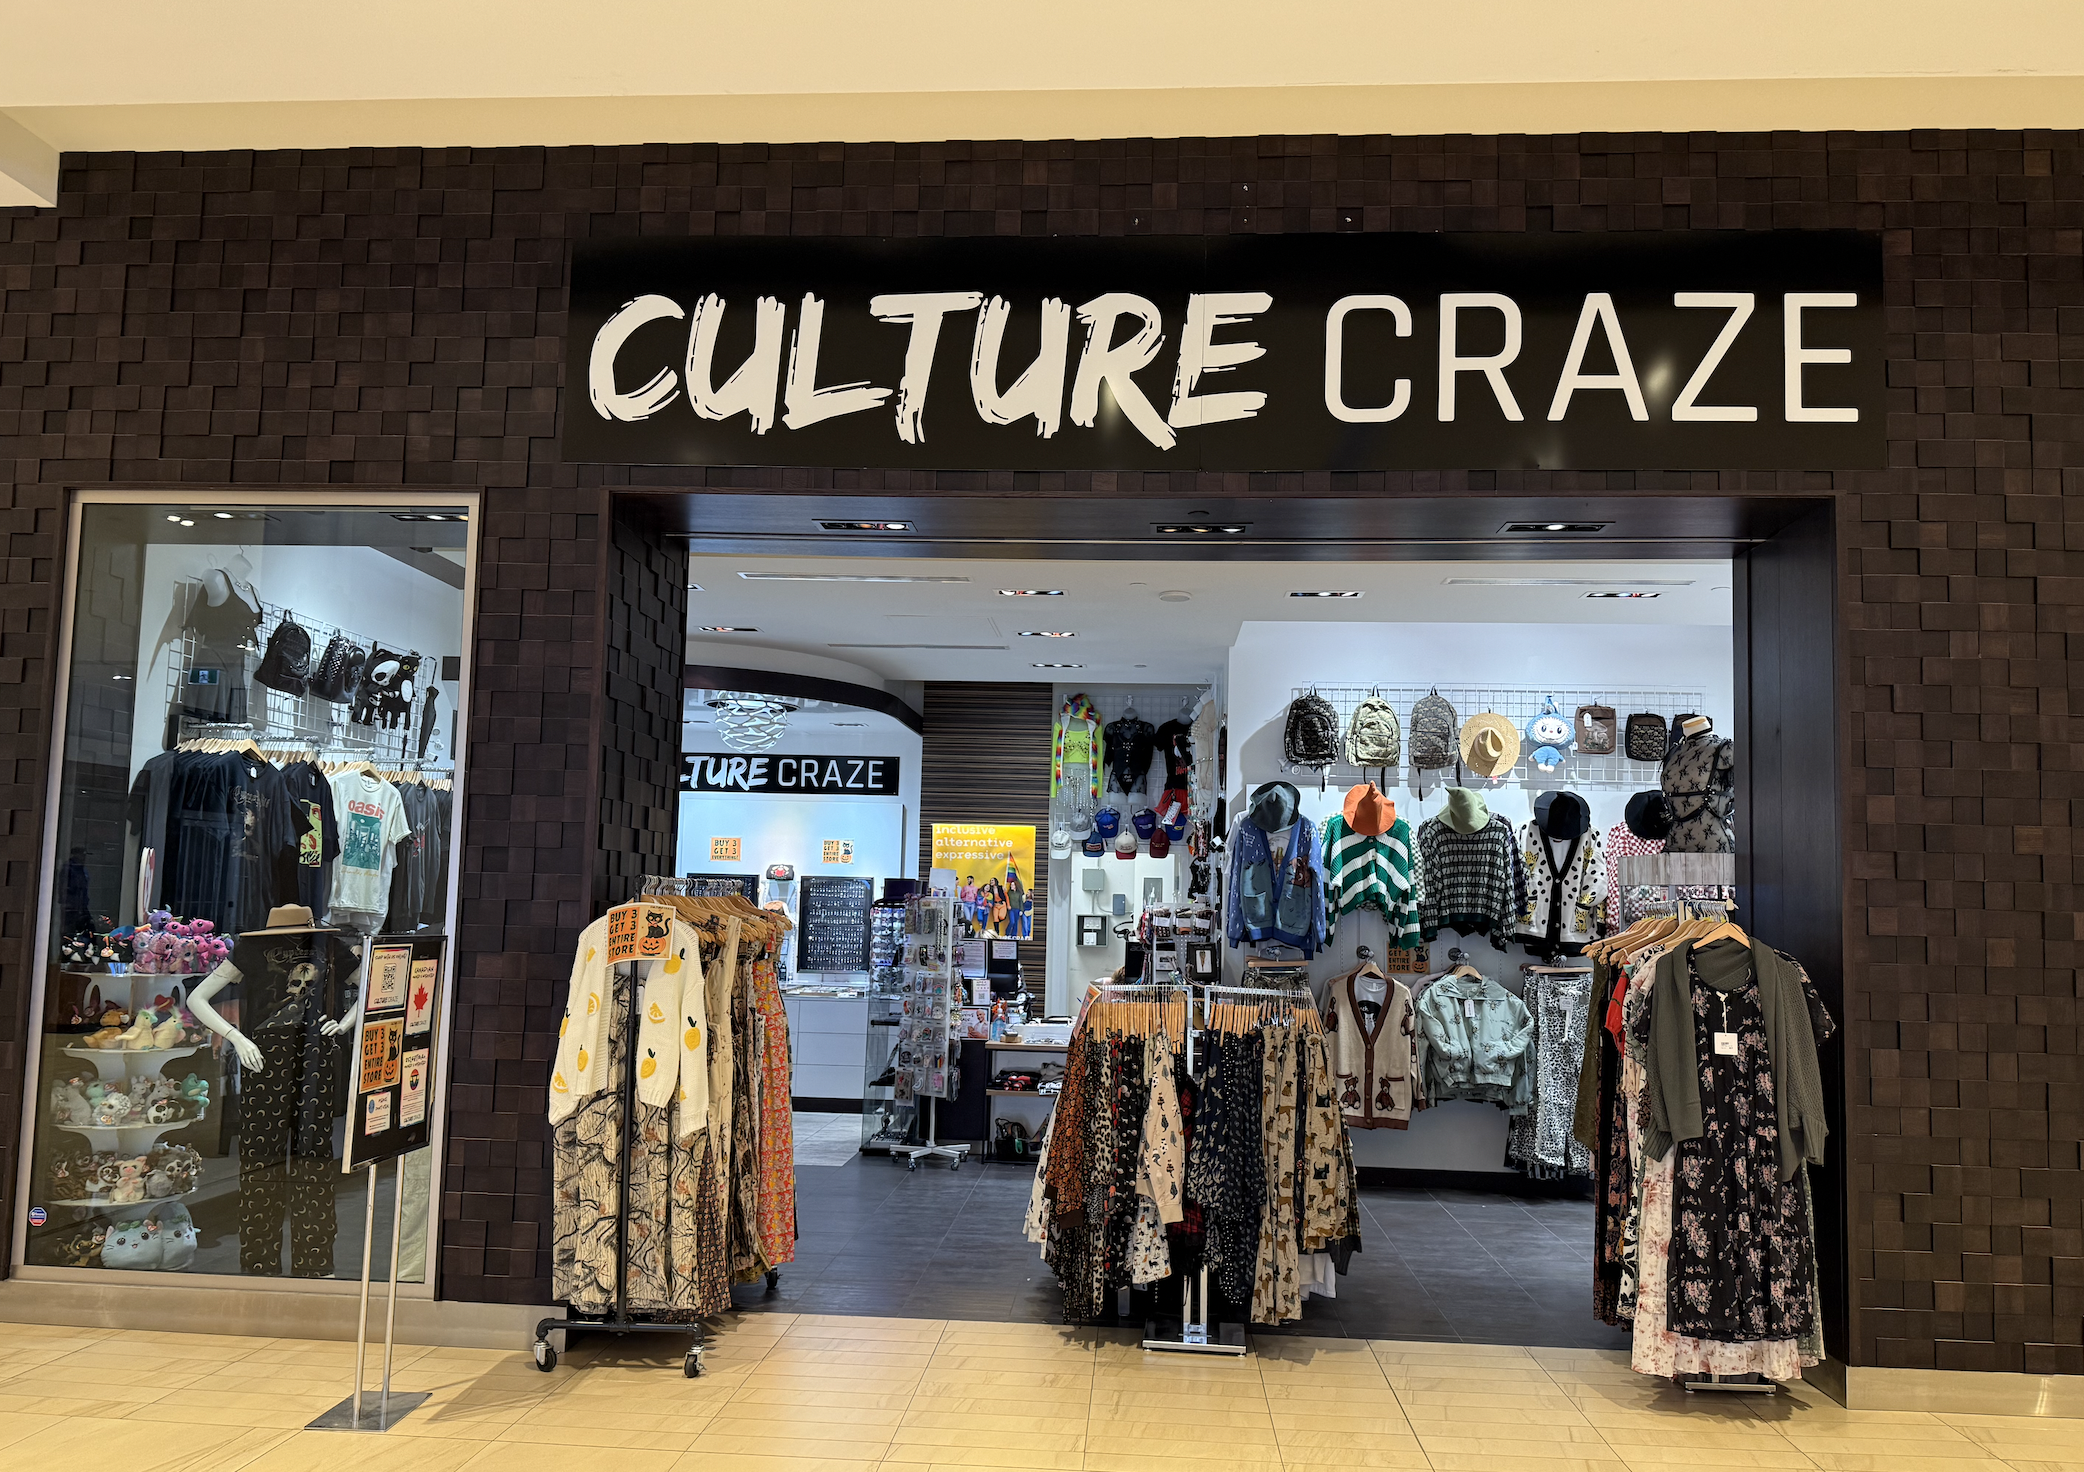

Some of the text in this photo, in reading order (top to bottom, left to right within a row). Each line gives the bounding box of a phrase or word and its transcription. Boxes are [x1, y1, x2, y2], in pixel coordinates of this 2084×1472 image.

[590, 292, 1859, 451] CULTURE CRAZE
[679, 756, 884, 791] TURE CRAZE
[348, 799, 385, 820] oasis
[936, 825, 996, 835] inclusive
[714, 839, 737, 847] BUY 3
[935, 837, 1013, 848] alternative
[713, 847, 737, 855] GET 3
[935, 850, 1004, 861] expressive
[610, 909, 638, 924] BUY 3
[609, 920, 637, 935] GET 3
[609, 932, 636, 947] ENTIRE
[608, 944, 635, 958] STORE
[365, 1027, 385, 1042] BUY 3
[364, 1041, 385, 1056] GET 3
[364, 1056, 383, 1070] ENTIRE
[363, 1069, 382, 1084] STORE
